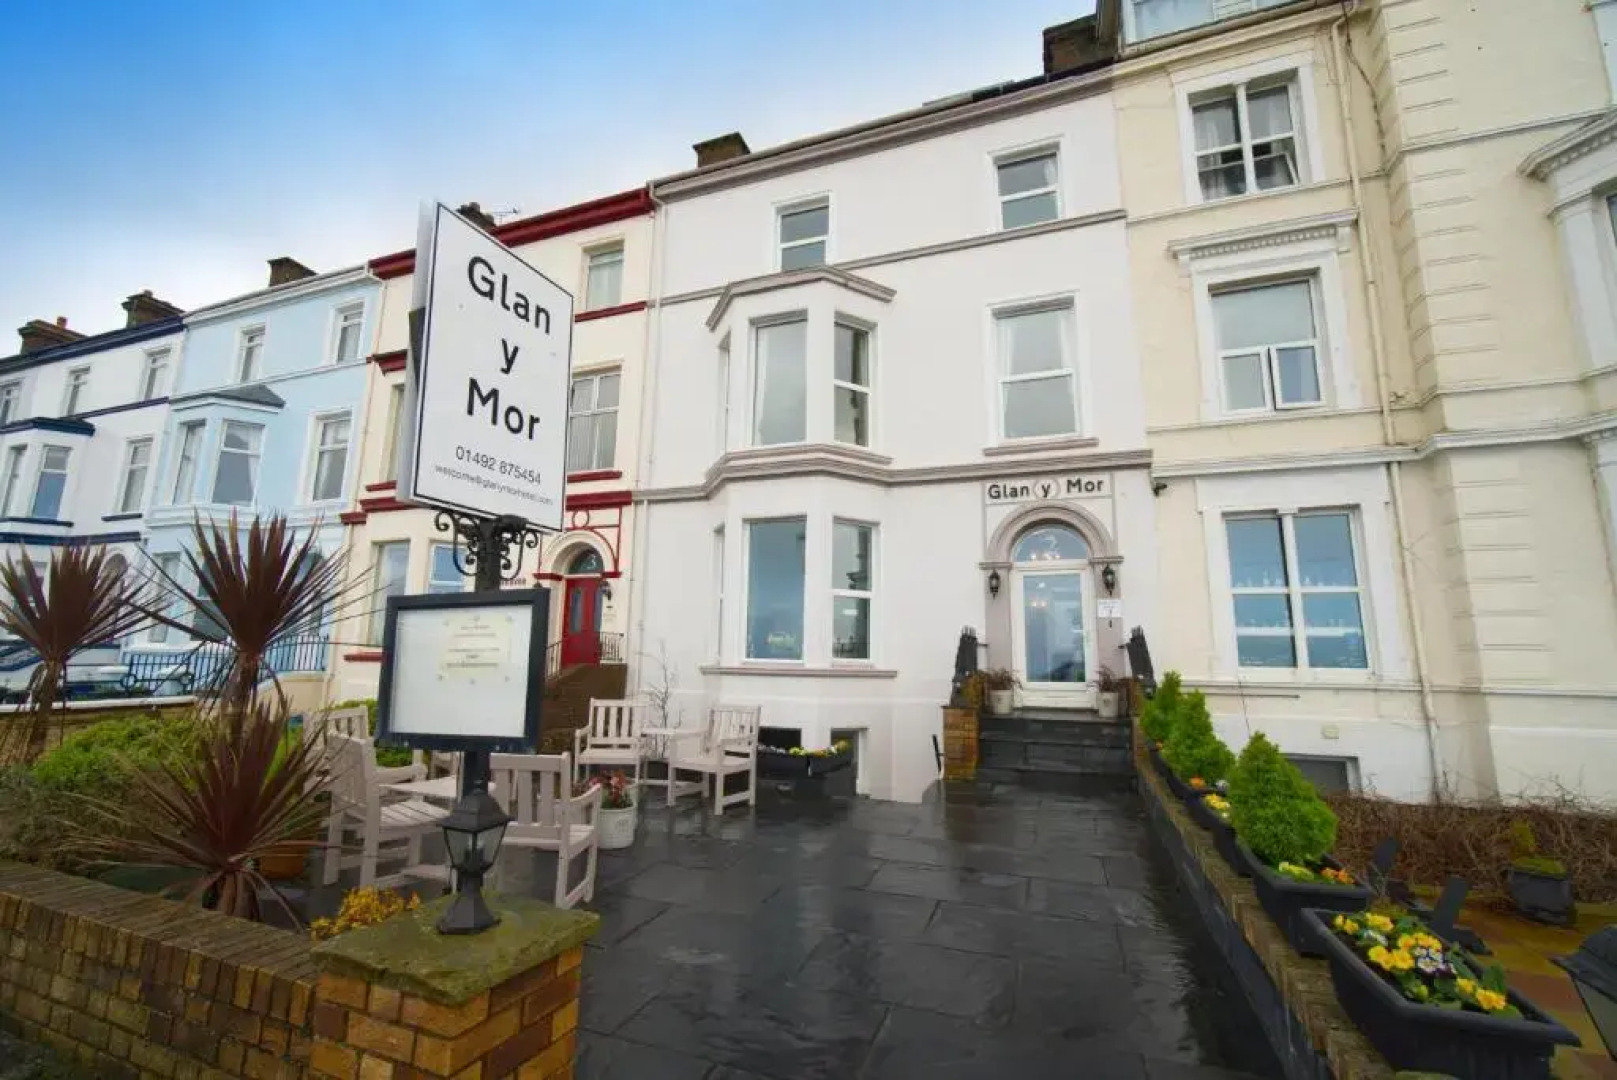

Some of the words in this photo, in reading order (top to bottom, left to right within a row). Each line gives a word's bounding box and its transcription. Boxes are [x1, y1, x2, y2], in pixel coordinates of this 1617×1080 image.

[468, 256, 550, 334] Glan
[500, 338, 519, 375] y
[467, 377, 540, 440] Mor
[455, 445, 496, 471] 01492
[499, 461, 541, 484] 875454
[988, 484, 1029, 499] Glan
[1041, 483, 1051, 498] y
[1066, 478, 1103, 493] Mor
